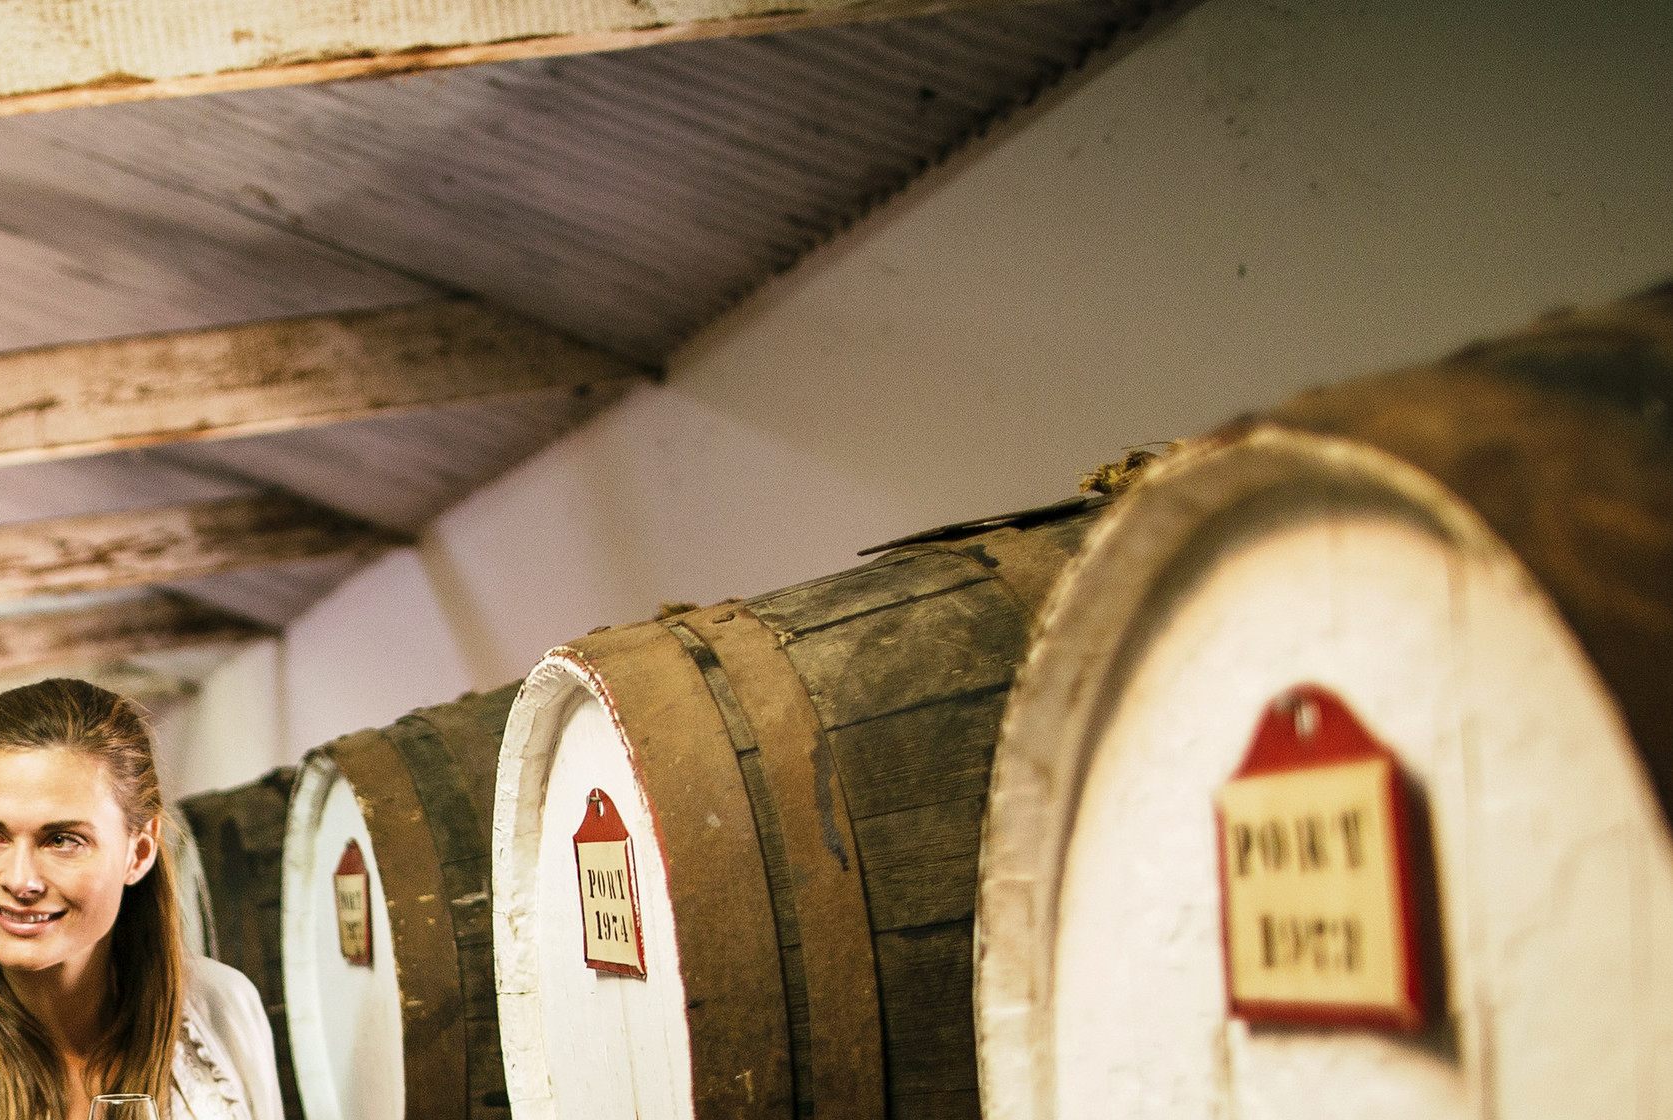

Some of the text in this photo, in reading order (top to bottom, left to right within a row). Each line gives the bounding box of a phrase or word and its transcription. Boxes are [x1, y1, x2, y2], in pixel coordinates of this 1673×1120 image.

[1233, 806, 1364, 878] PORT
[587, 868, 625, 900] PORT
[595, 910, 629, 943] 1974
